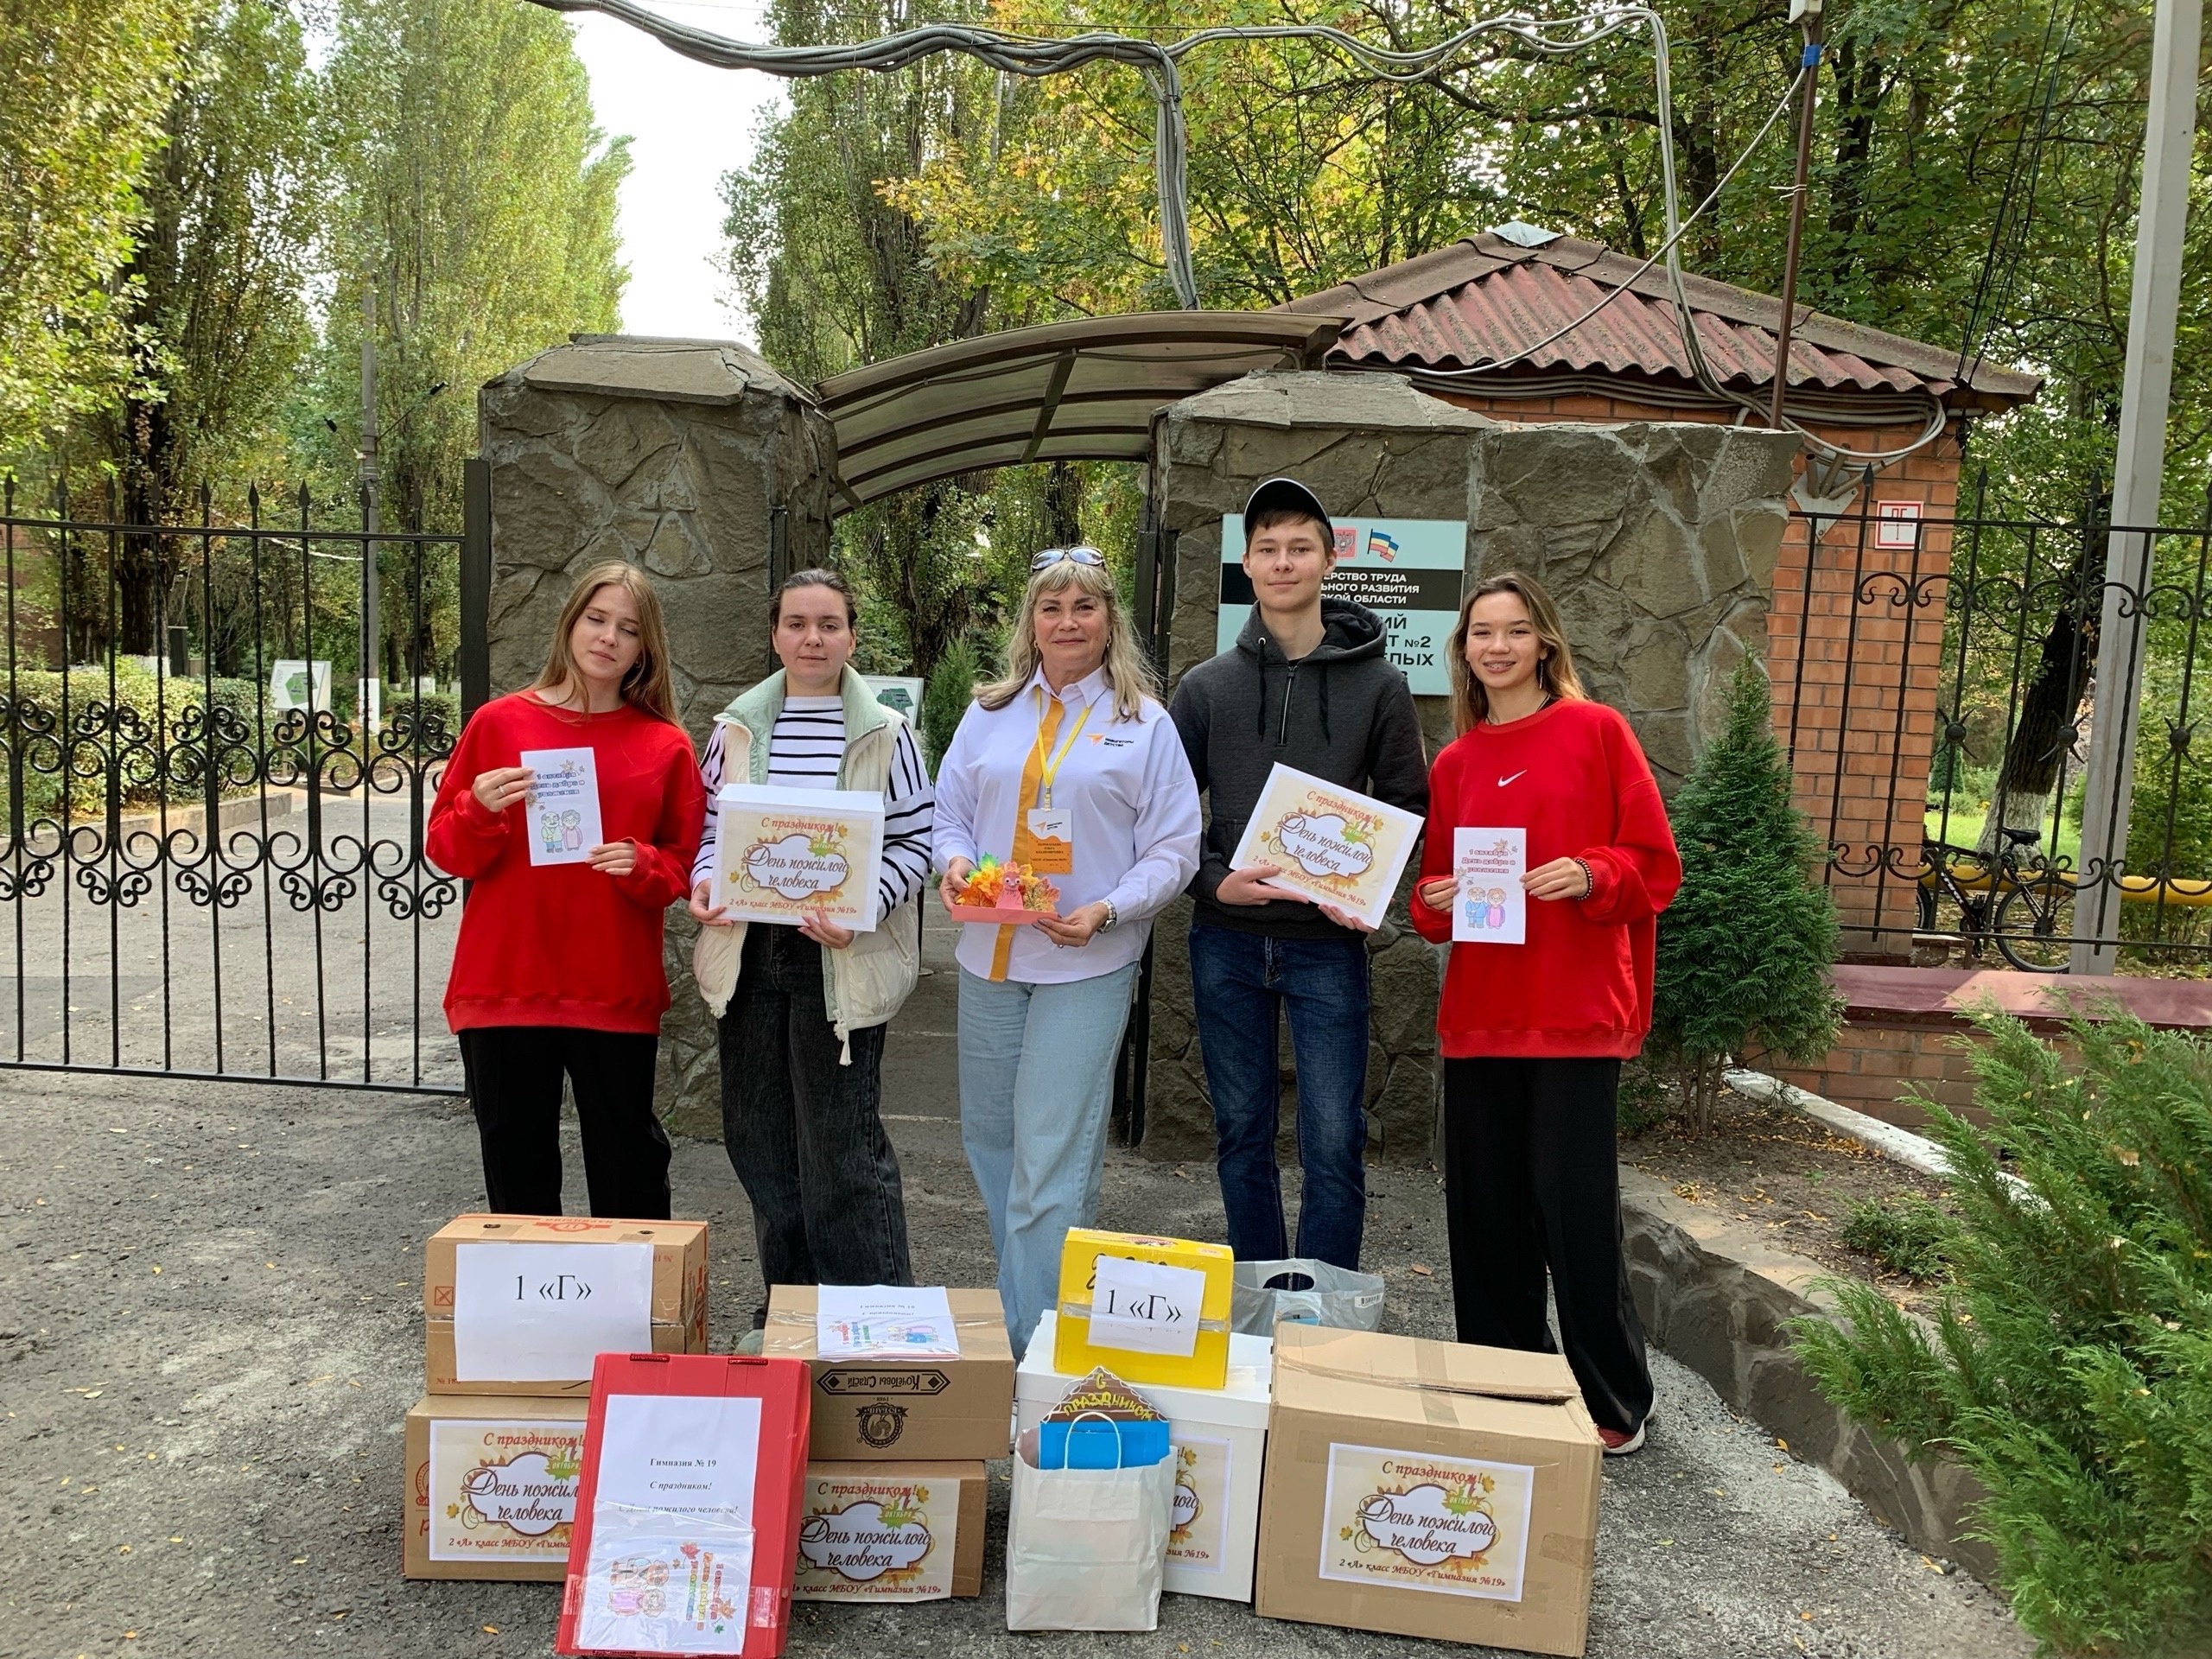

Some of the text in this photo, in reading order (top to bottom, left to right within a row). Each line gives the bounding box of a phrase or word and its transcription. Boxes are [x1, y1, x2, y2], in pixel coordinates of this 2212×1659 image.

[1370, 573, 1407, 583] ТРУДА
[1361, 584, 1420, 594] РАЗВИТИЯ
[1353, 594, 1407, 604] ОБЛАСТИ
[1404, 636, 1432, 648] №2
[1306, 791, 1377, 823] С праздником!
[761, 817, 838, 833] С праздником!
[1279, 812, 1374, 865] День пожилого
[741, 843, 849, 873] День пожилого
[1294, 844, 1341, 872] человека
[768, 870, 819, 889] человека
[1287, 869, 1313, 883] МБОУ
[769, 901, 795, 911] МБОУ
[516, 1274, 592, 1300] 1 «Г»
[1106, 1289, 1182, 1323] 1 «Г»
[1096, 1373, 1107, 1389] С
[1063, 1391, 1154, 1421] ПРАЗДНИКОМ
[484, 1432, 583, 1449] С праздником!
[650, 1458, 717, 1467] Гимназия № 19
[461, 1467, 519, 1497] День
[1382, 1461, 1483, 1484] С праздником!
[650, 1480, 713, 1491] С праздником!
[817, 1482, 918, 1498] С праздником!
[498, 1498, 563, 1521] человека
[1356, 1495, 1497, 1536] День пожилого
[799, 1516, 850, 1544] День
[854, 1531, 932, 1545] пожилого
[456, 1538, 473, 1547] «А»
[475, 1540, 499, 1548] класс
[501, 1539, 536, 1548] МБОУ
[1390, 1530, 1457, 1553] человека
[828, 1545, 893, 1567] человека
[1184, 1549, 1210, 1559] №19»
[1347, 1560, 1363, 1568] «А»
[1365, 1563, 1390, 1572] класс
[1392, 1566, 1427, 1576] МБОУ
[1427, 1570, 1478, 1583] «Гимназия
[1478, 1576, 1506, 1586] №19»
[803, 1584, 827, 1593] класс
[829, 1584, 863, 1594] МБОУ
[864, 1585, 914, 1593] «Гимназия
[915, 1585, 941, 1593] №19»
